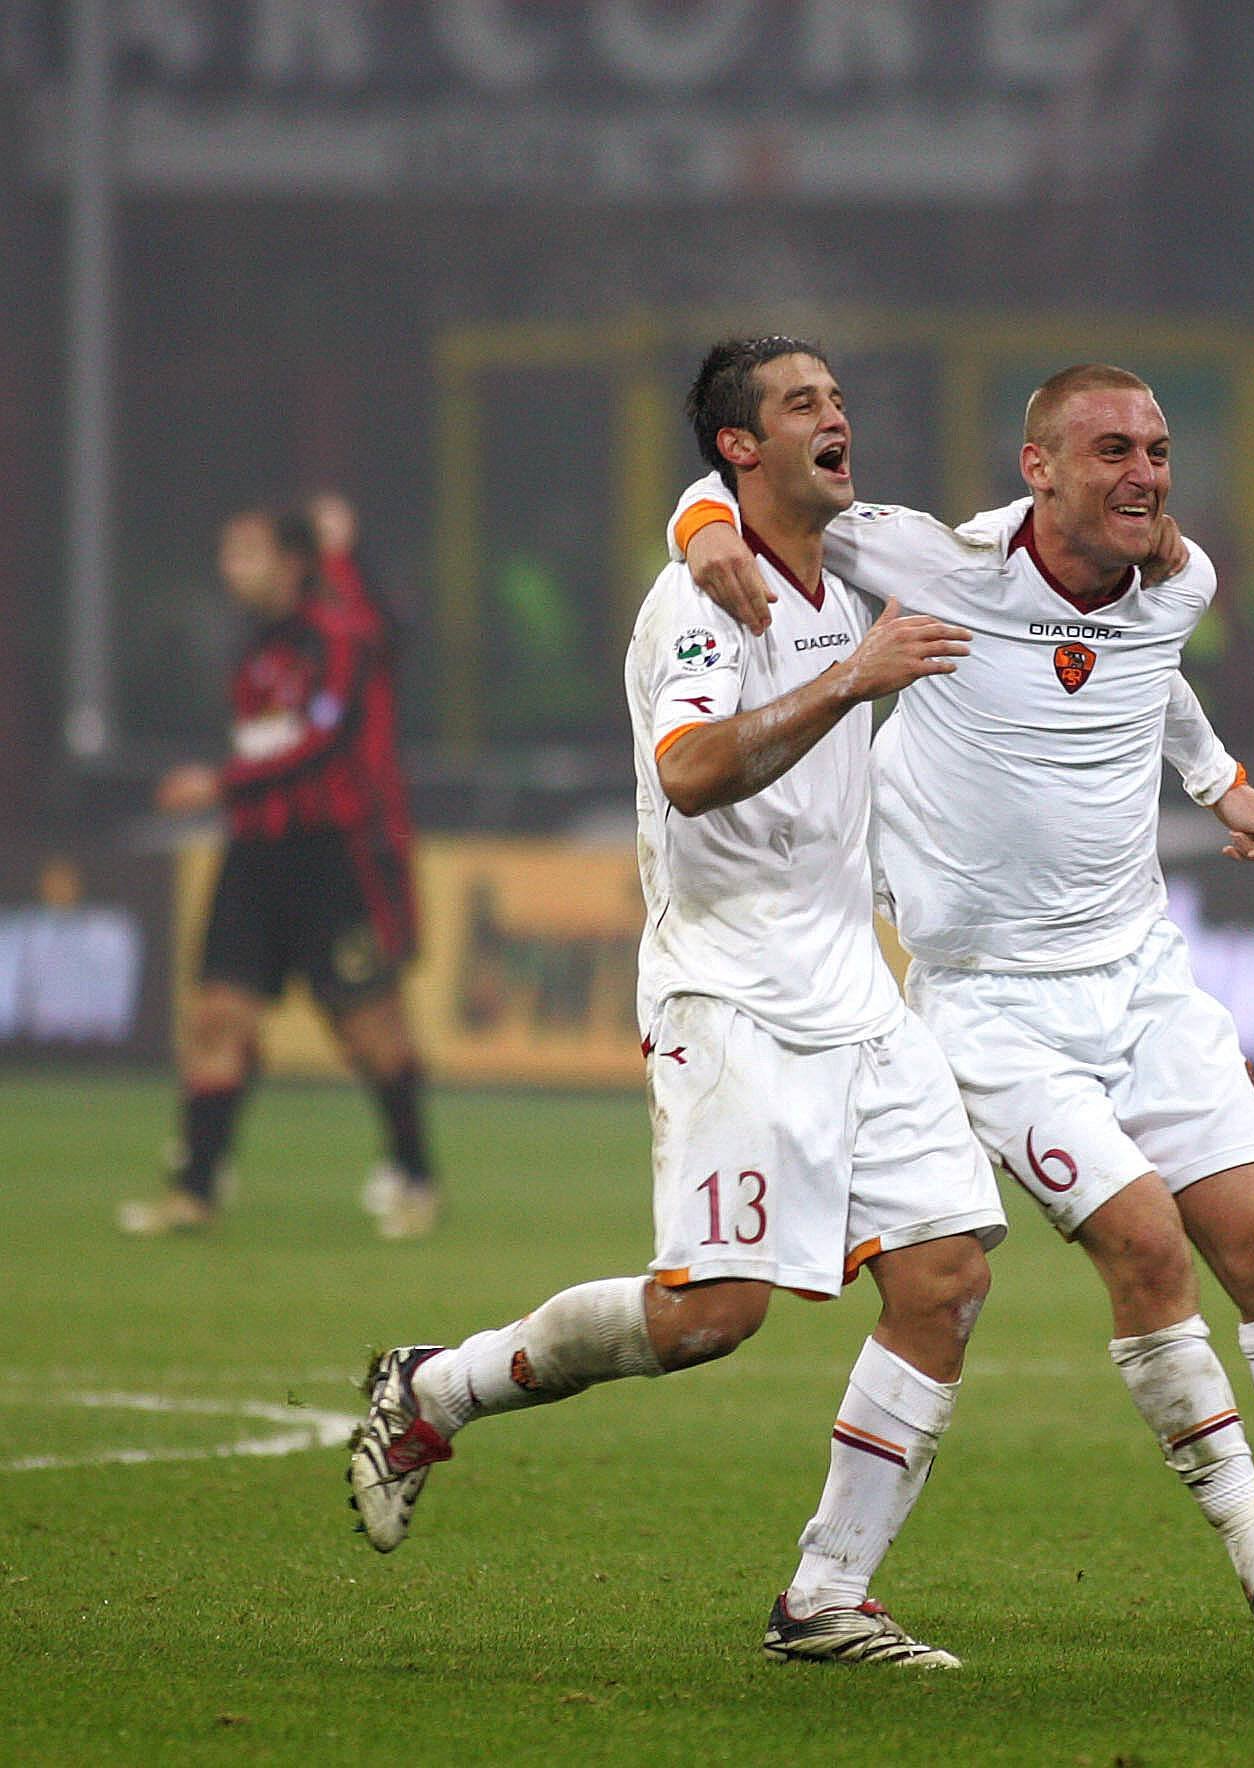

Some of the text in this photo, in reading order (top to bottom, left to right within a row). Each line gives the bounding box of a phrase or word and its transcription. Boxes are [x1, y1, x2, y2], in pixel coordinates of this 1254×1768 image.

[1029, 623, 1122, 640] DIADORA
[1025, 1125, 1078, 1193] 6
[696, 1169, 768, 1246] 13
